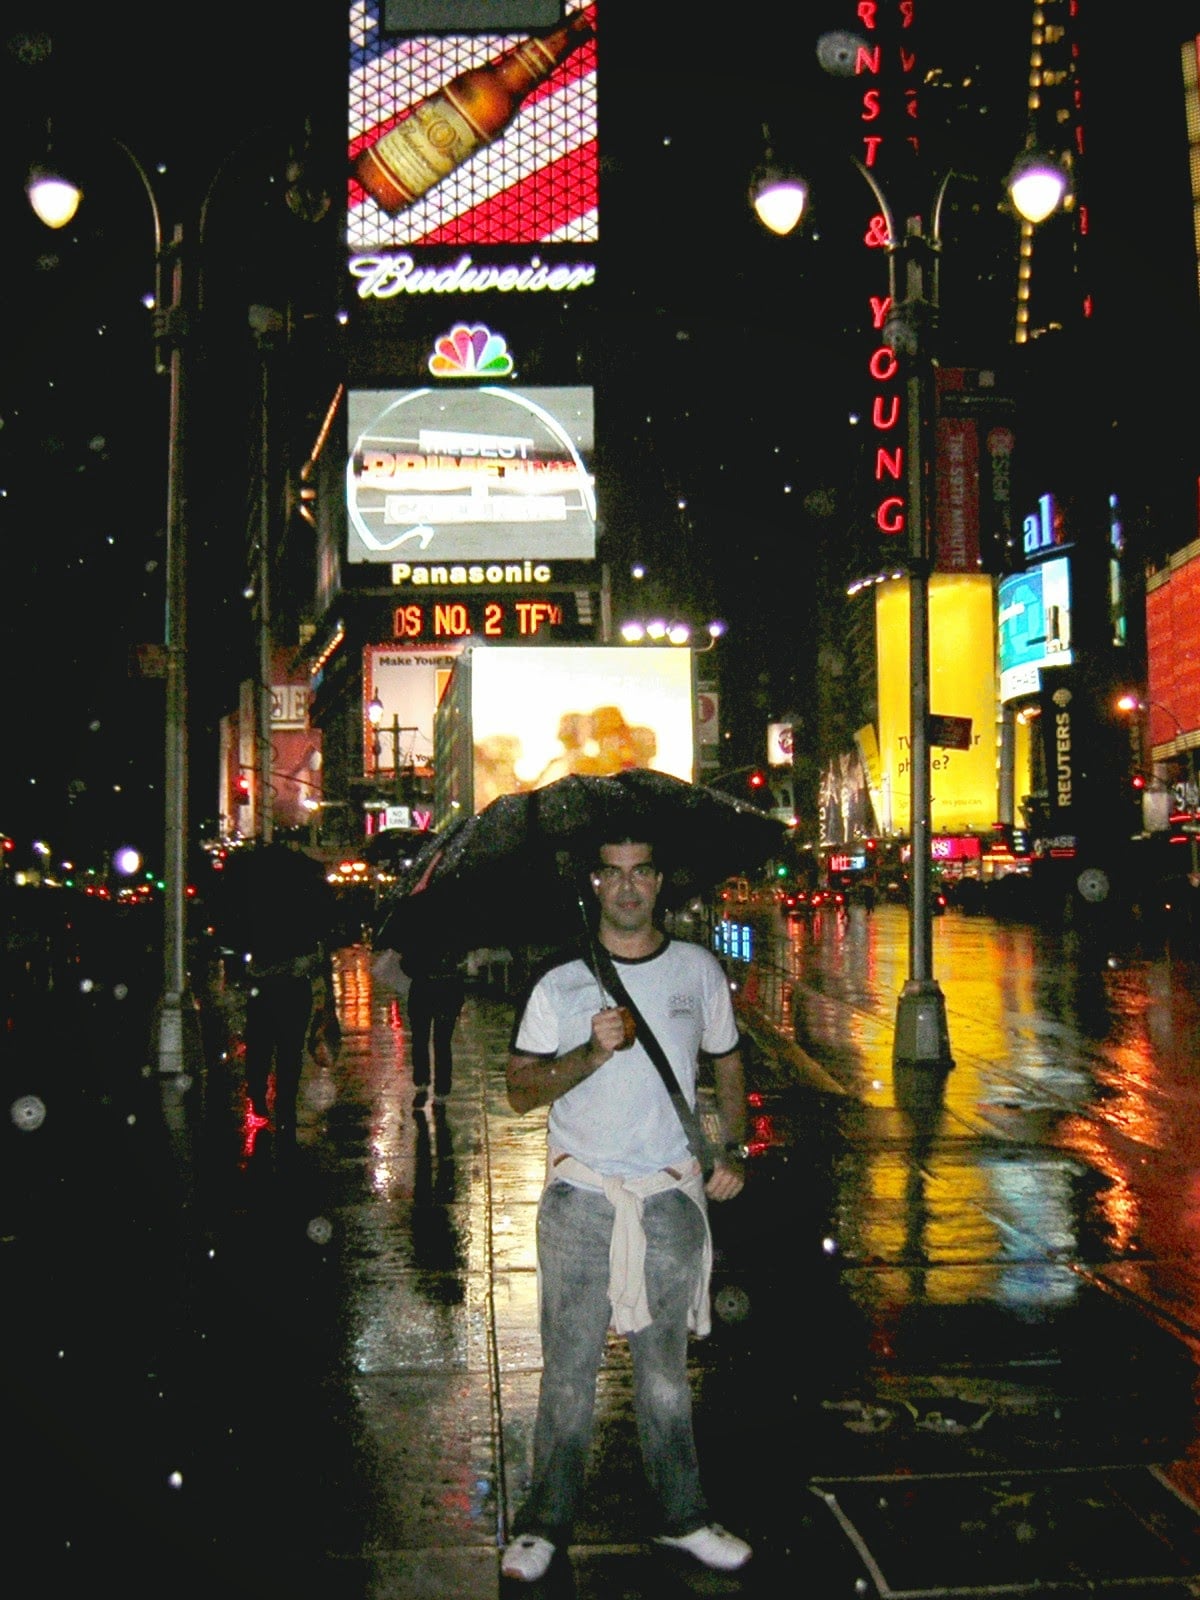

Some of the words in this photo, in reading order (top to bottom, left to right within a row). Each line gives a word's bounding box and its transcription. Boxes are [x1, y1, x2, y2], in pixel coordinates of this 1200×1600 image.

[864, 213, 890, 249] &
[348, 254, 597, 298] Budweiser
[869, 295, 905, 535] YOUNG
[391, 562, 552, 586] Panasonic
[434, 604, 472, 636] NO.
[485, 603, 503, 636] 2
[379, 655, 412, 667] Make
[414, 655, 443, 666] Your
[898, 755, 950, 777] phe?
[1055, 712, 1073, 807] REUTERS
